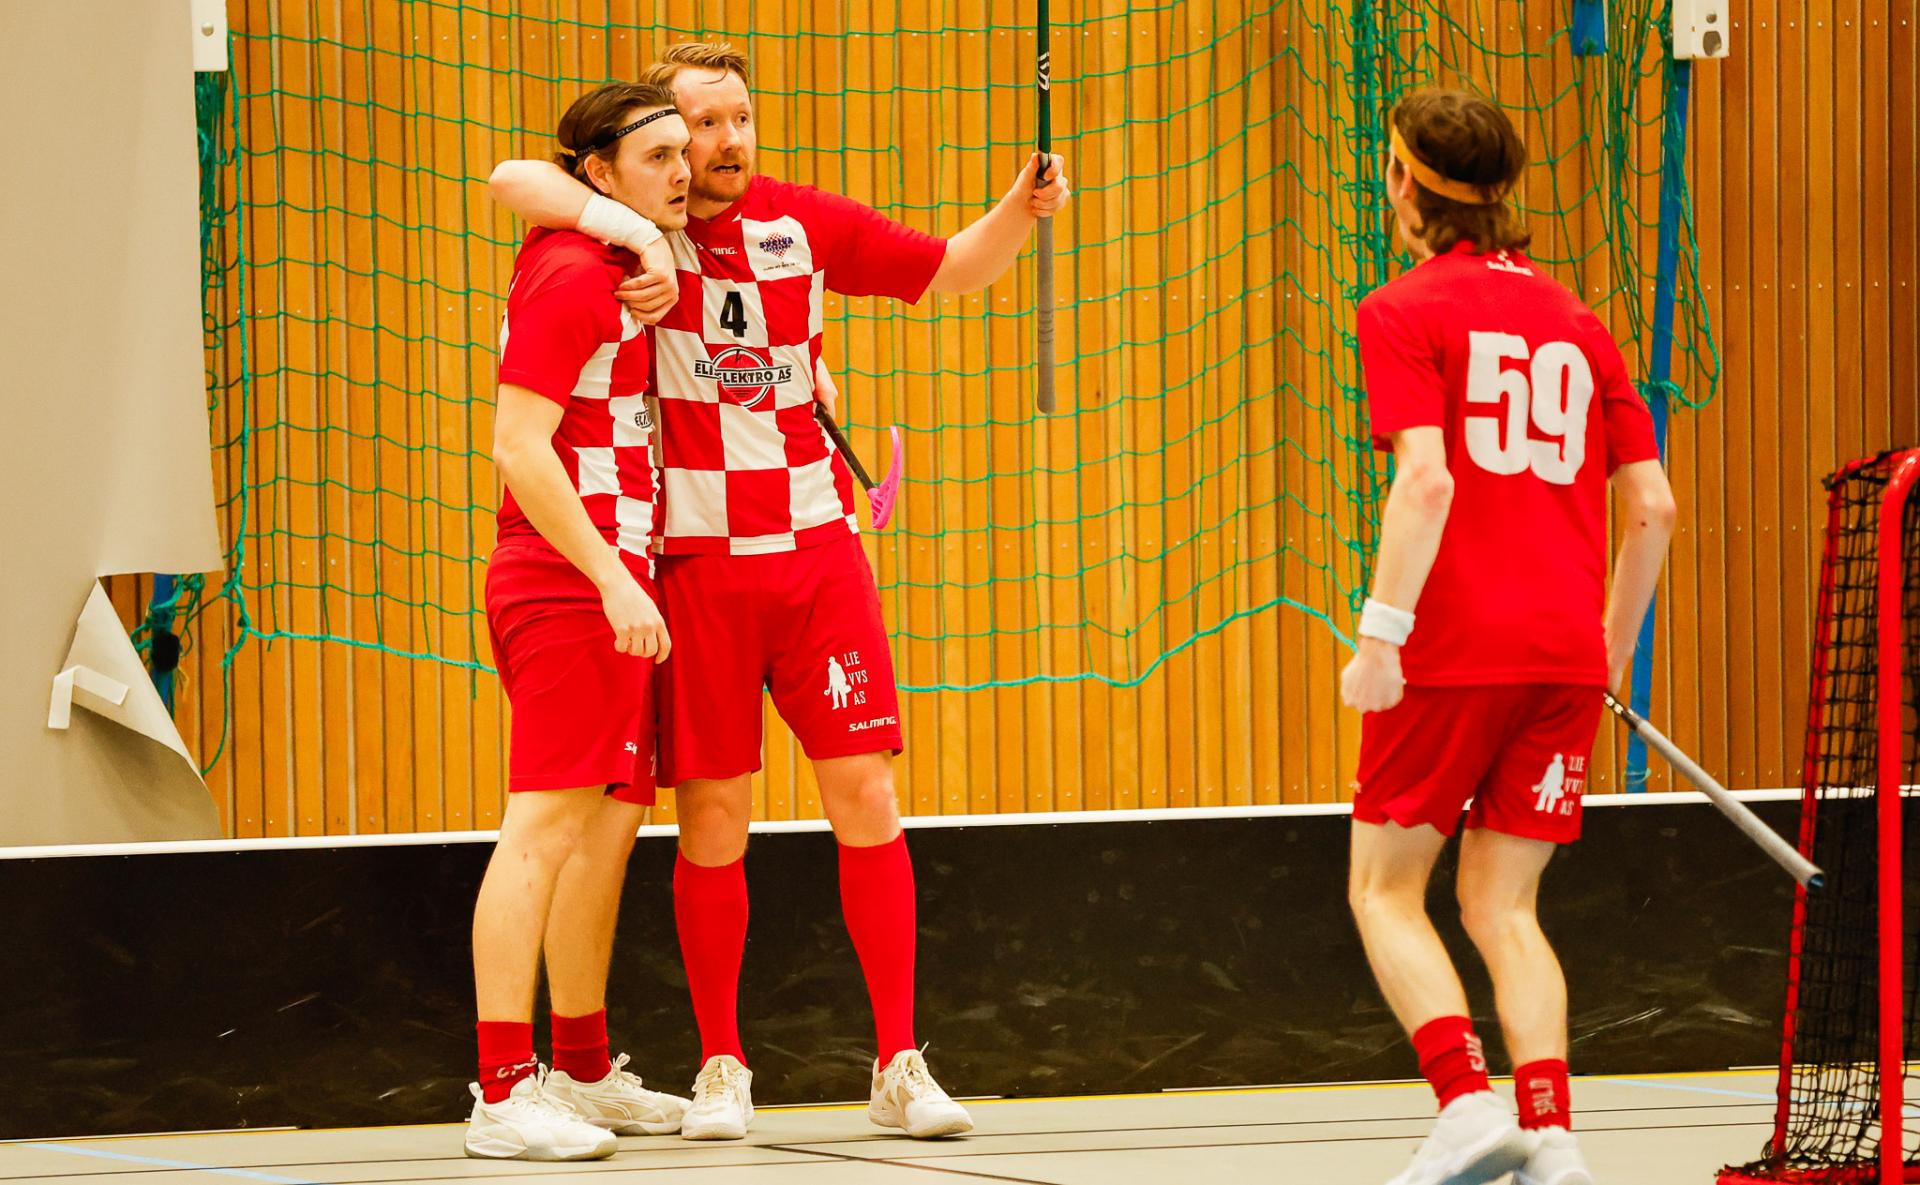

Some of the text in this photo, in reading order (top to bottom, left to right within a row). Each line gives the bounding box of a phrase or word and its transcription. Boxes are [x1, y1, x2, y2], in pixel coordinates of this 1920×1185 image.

[719, 291, 748, 338] 4
[778, 368, 792, 381] AS
[1465, 330, 1594, 485] 59
[843, 651, 860, 666] LIE
[848, 670, 868, 685] VVS
[854, 691, 866, 705] AS
[1568, 755, 1584, 772] LIE
[1559, 801, 1574, 816] AS
